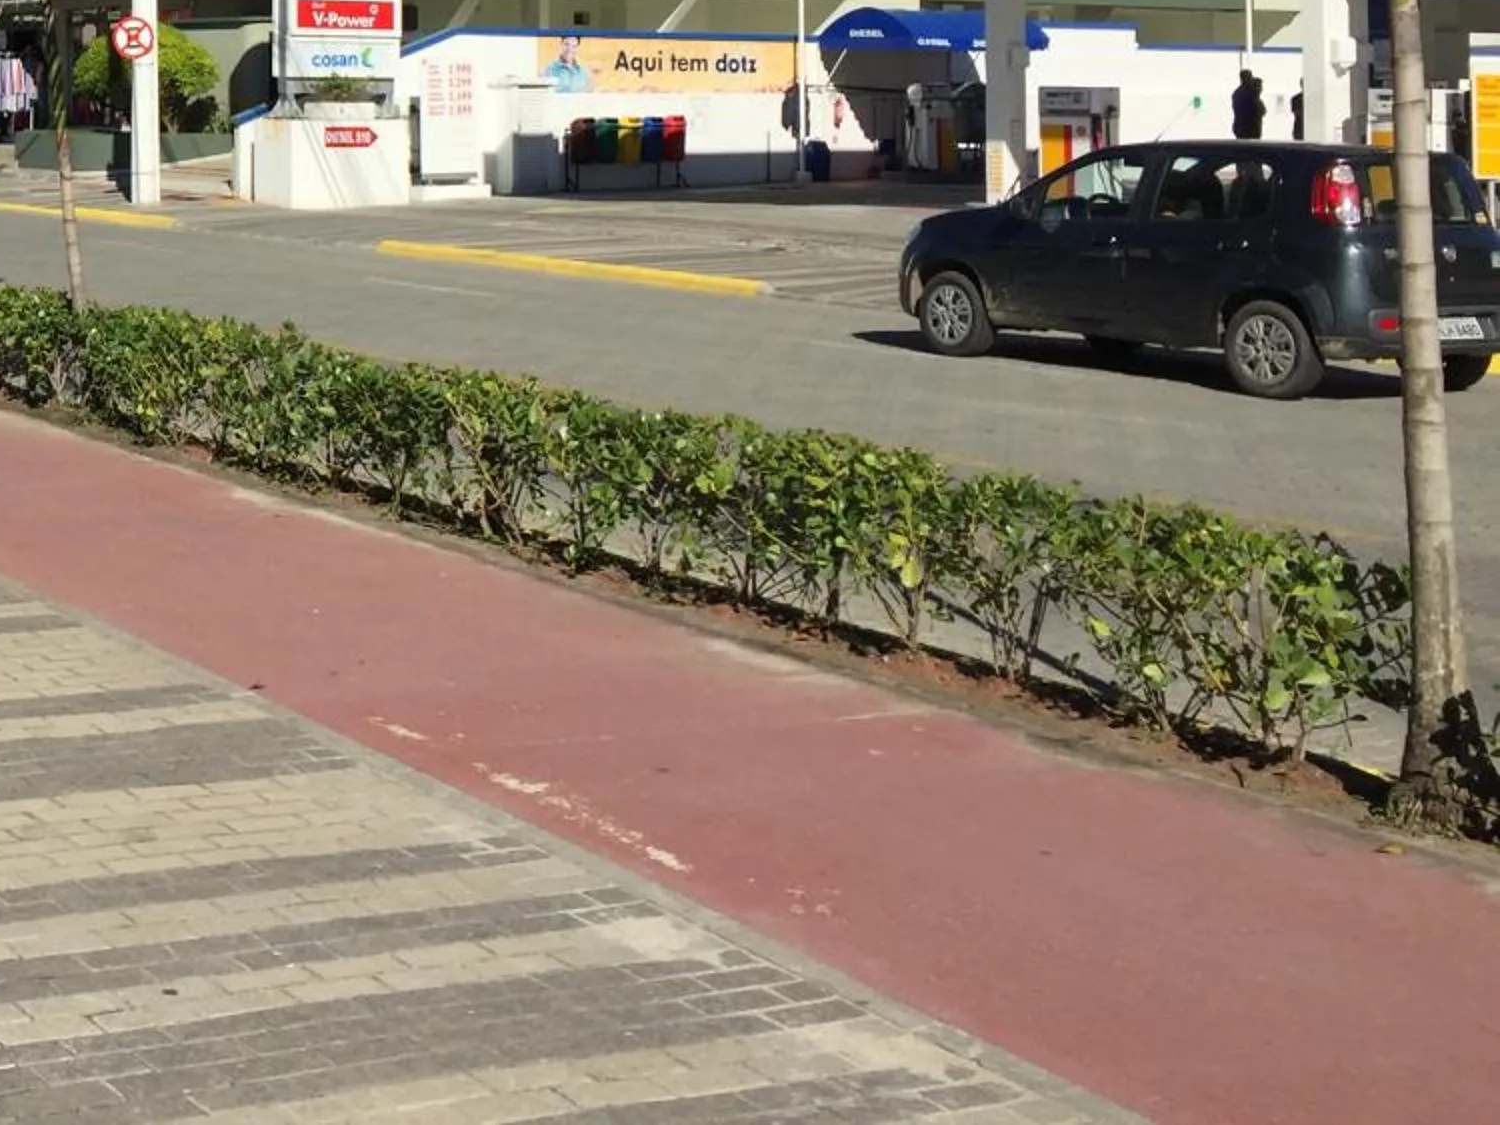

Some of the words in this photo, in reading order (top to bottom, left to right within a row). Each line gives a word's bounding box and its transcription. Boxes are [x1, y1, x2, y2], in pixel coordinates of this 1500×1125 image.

[312, 10, 376, 28] V-Power
[311, 53, 358, 68] cosan
[614, 50, 664, 77] Aqui
[670, 53, 709, 72] tem
[715, 53, 757, 74] dotz
